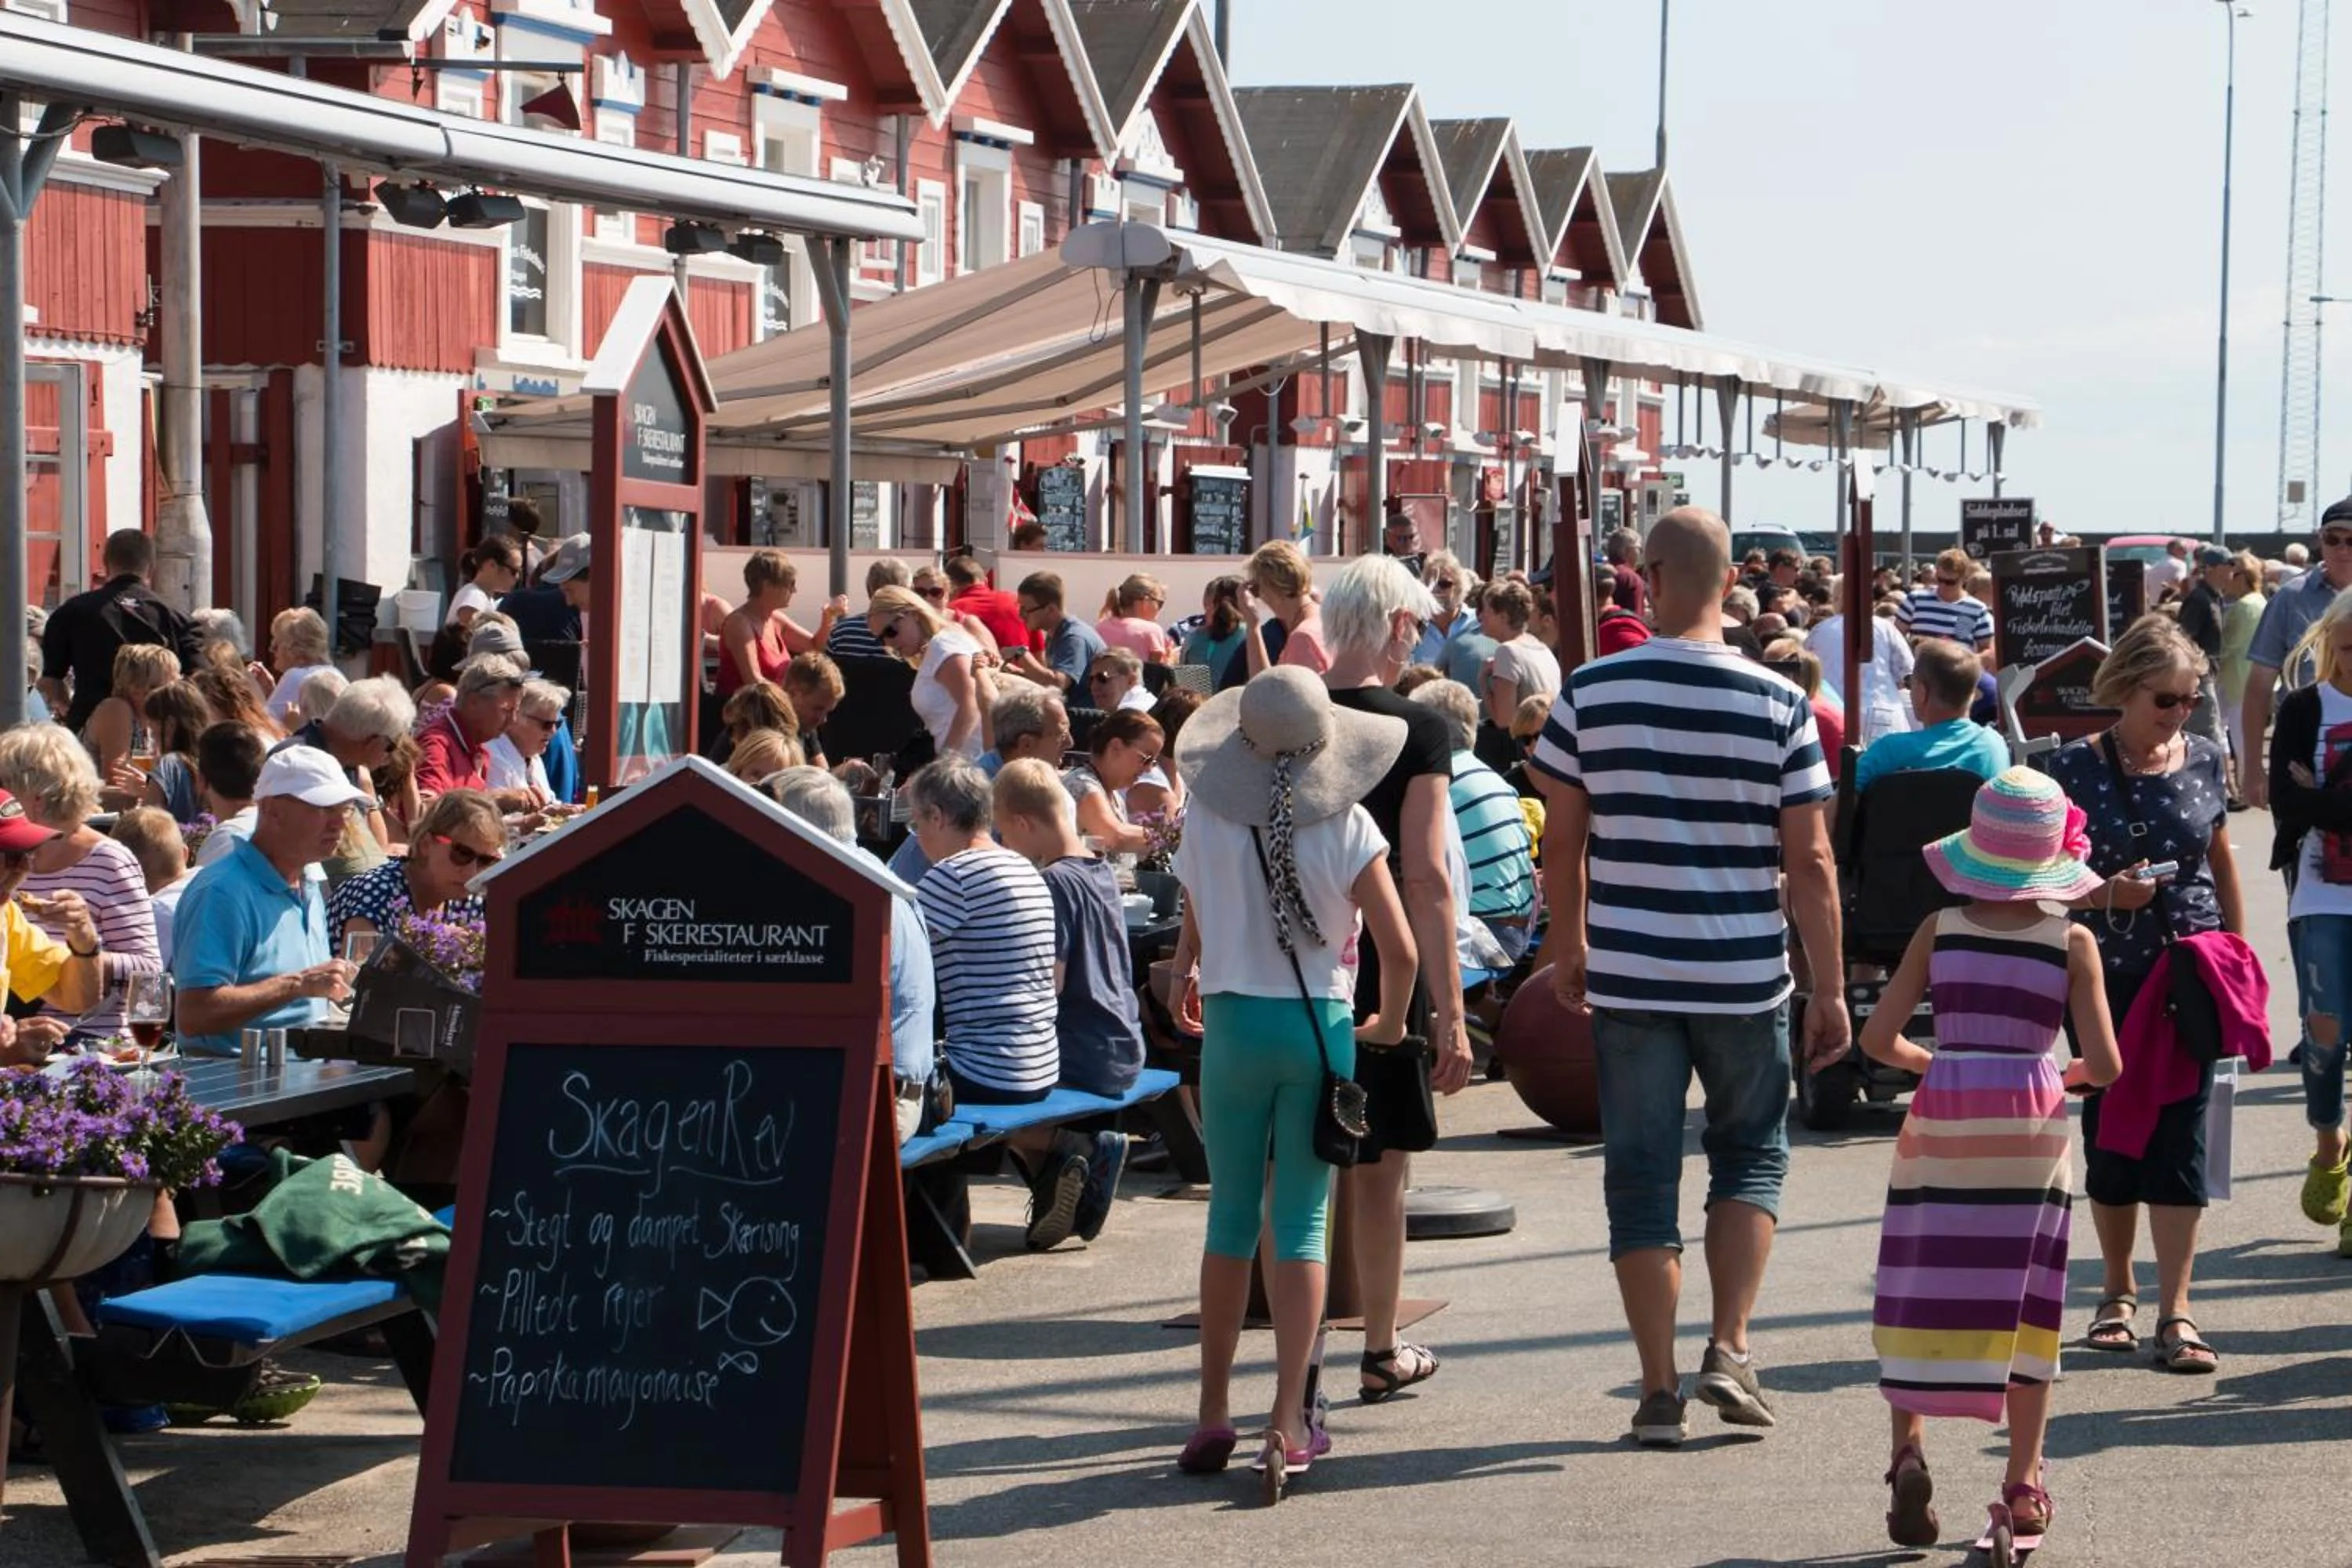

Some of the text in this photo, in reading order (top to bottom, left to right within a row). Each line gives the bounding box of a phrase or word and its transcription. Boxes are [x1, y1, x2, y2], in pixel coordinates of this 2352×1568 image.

[2003, 522, 2020, 539] sal
[608, 897, 695, 920] SKAGEN
[644, 949, 825, 967] Fiskespecialiteter i særklasse
[589, 1212, 614, 1280] og
